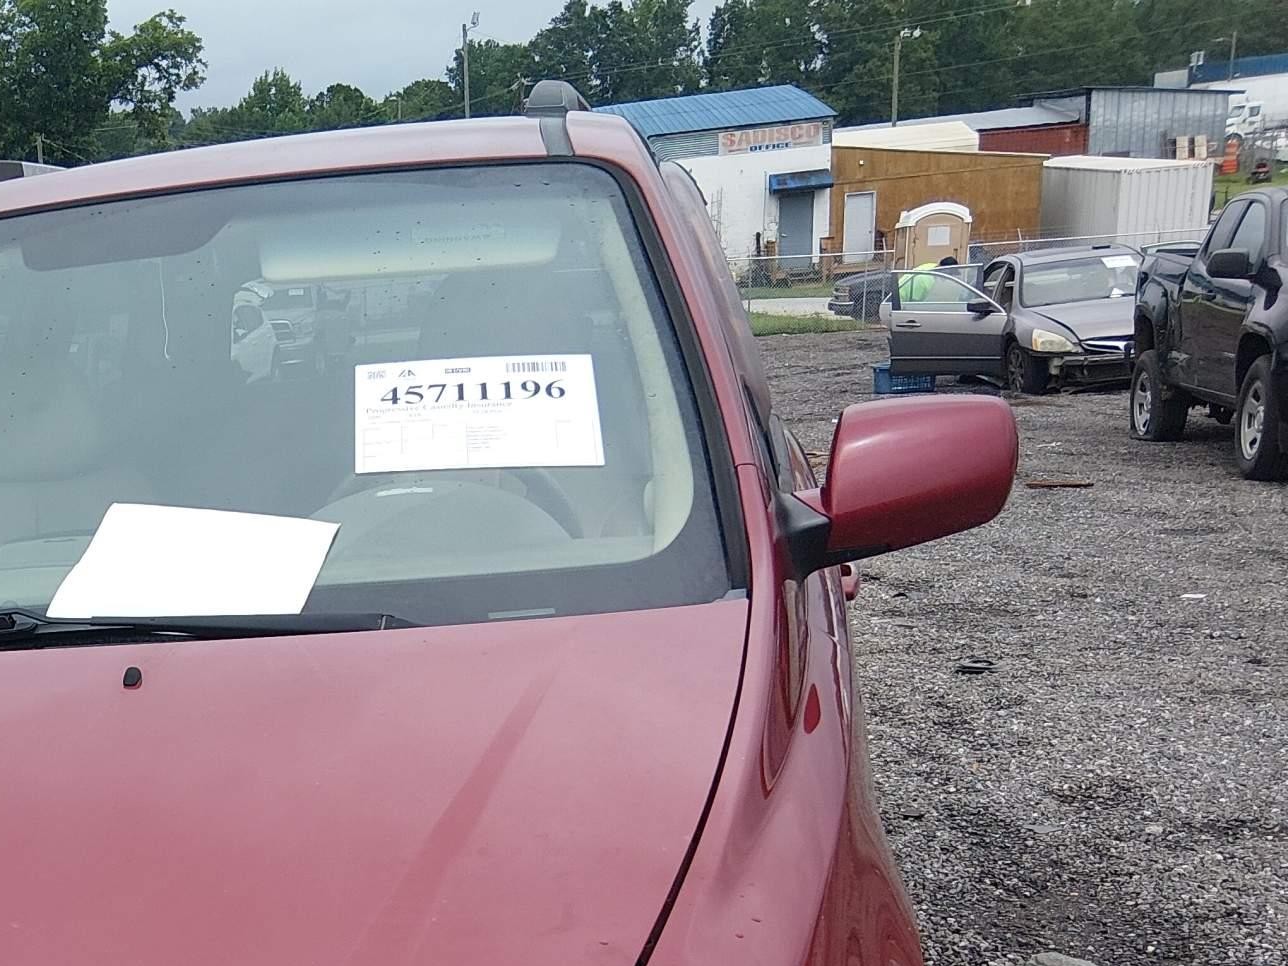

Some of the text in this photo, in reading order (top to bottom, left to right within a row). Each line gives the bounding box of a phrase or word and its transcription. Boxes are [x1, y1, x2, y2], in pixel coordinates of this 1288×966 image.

[722, 124, 820, 147] SADISCO
[749, 142, 792, 152] OFFICE
[380, 379, 566, 405] 45711196
